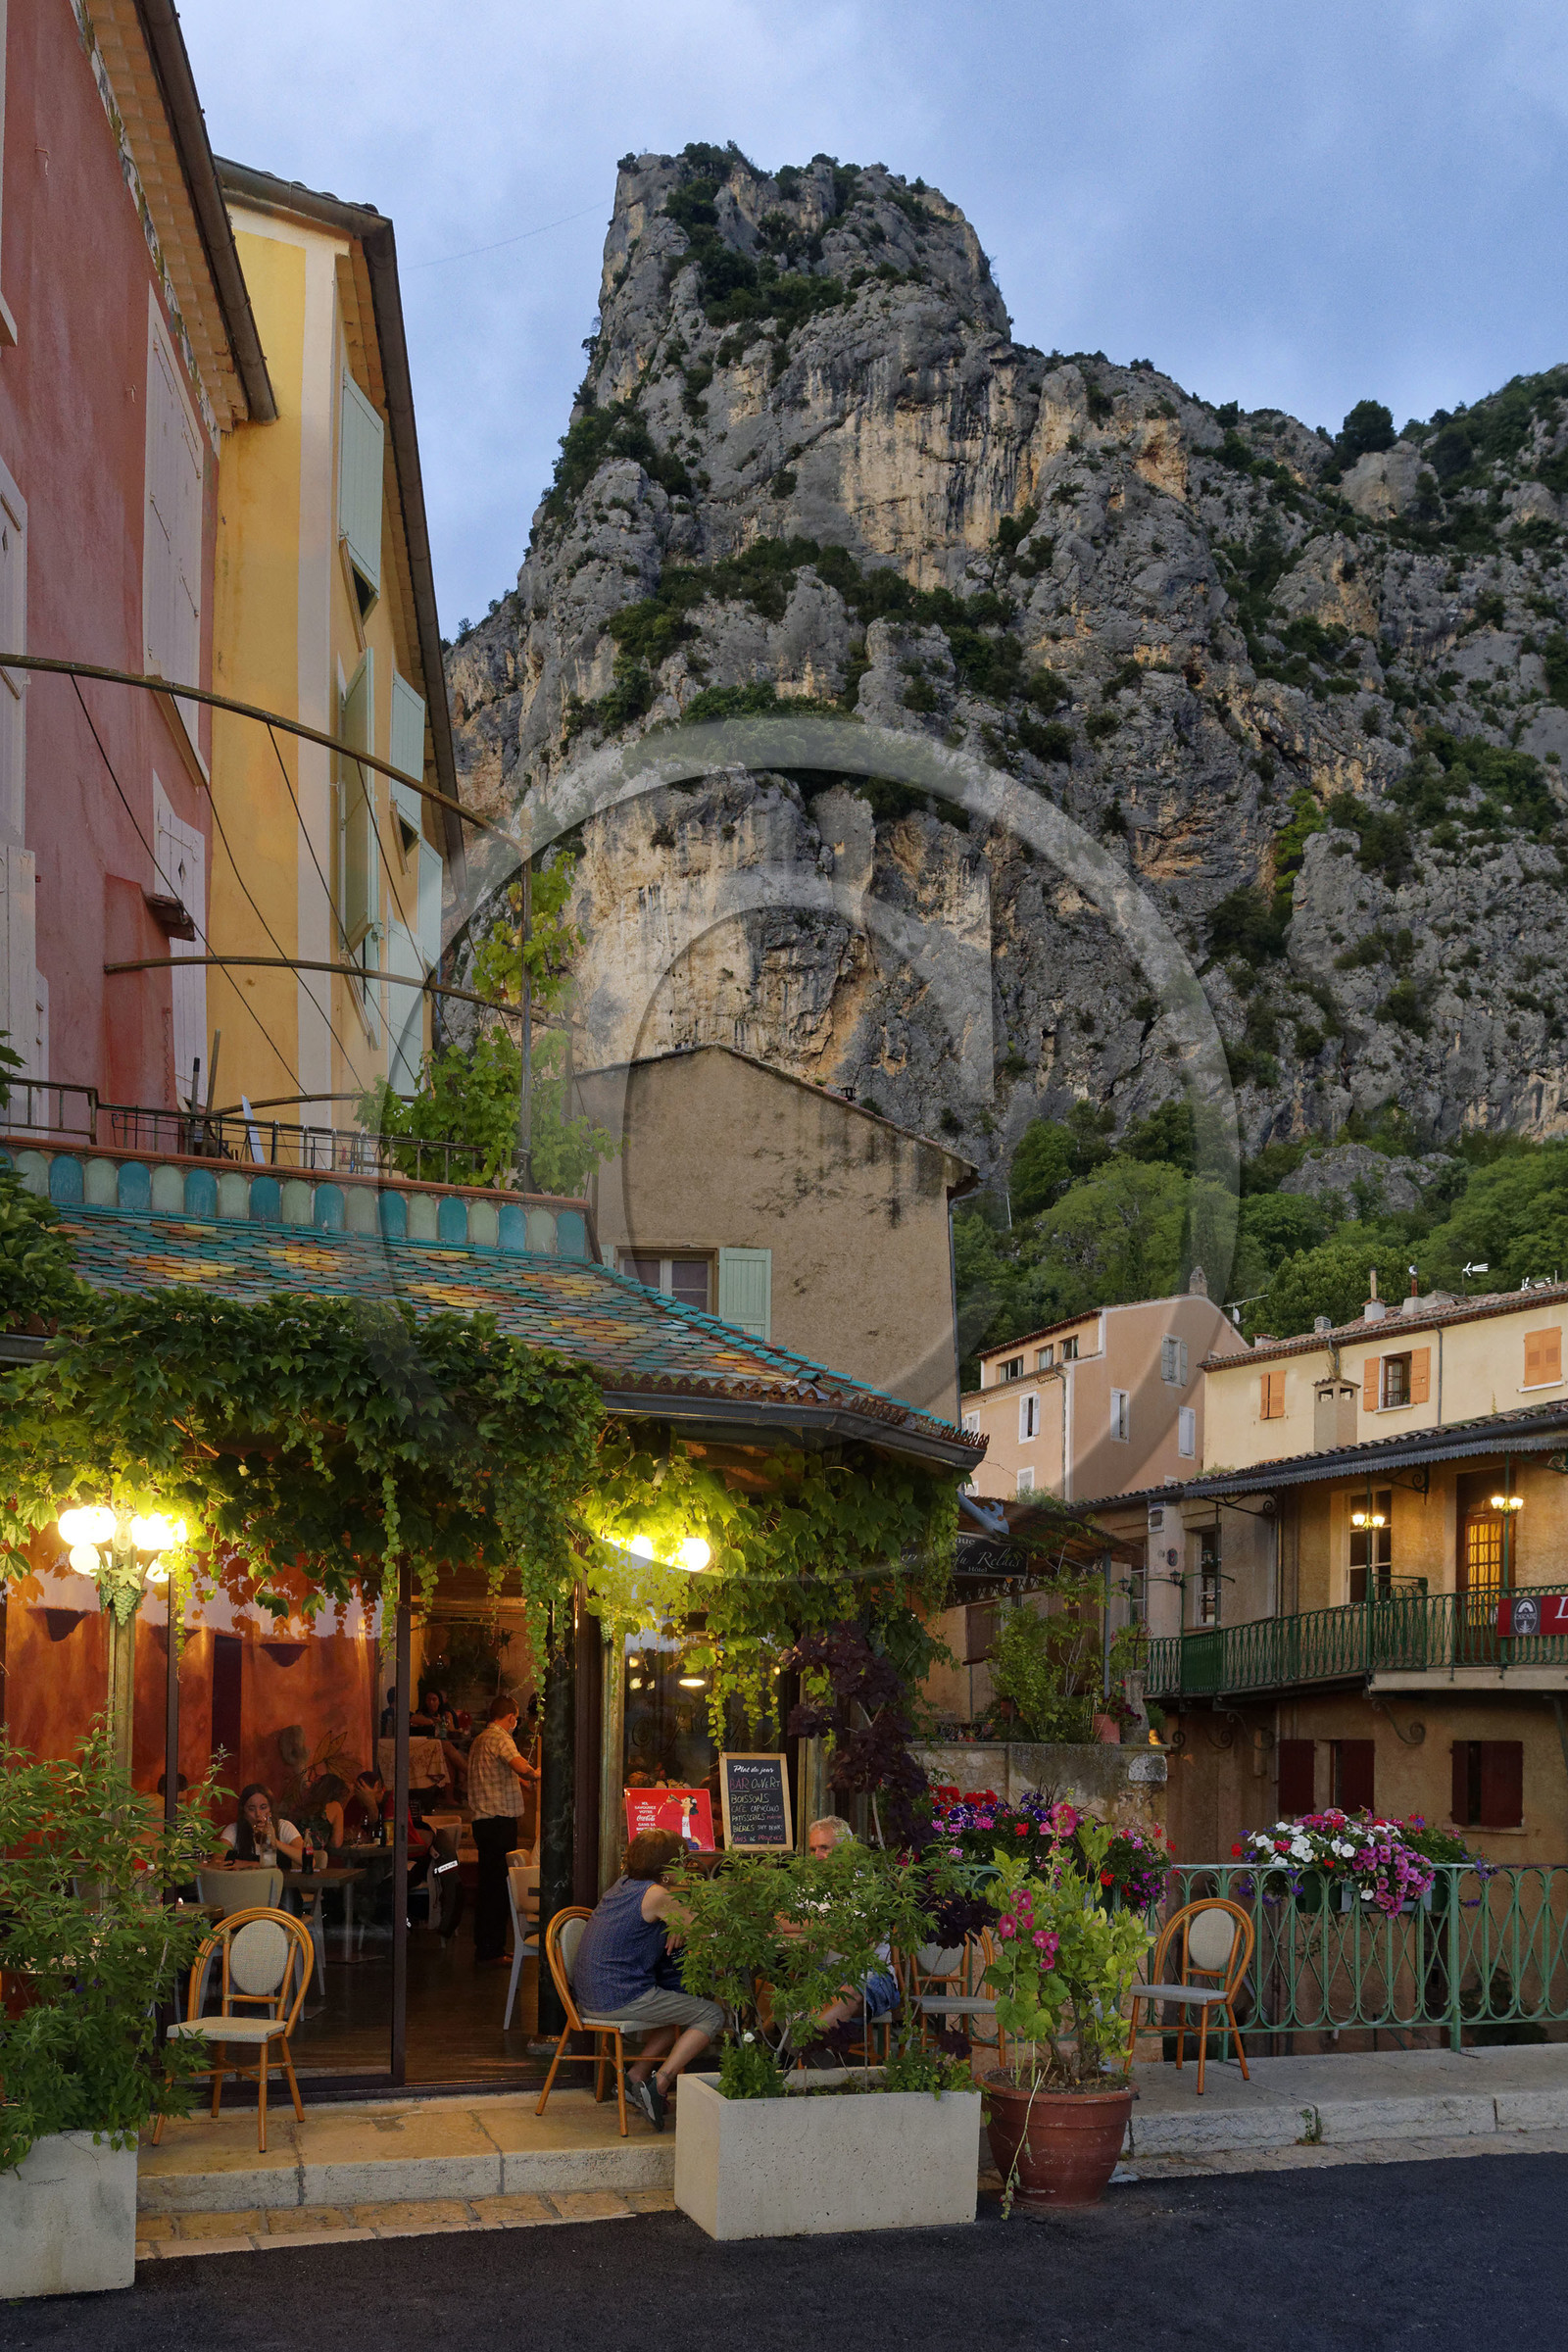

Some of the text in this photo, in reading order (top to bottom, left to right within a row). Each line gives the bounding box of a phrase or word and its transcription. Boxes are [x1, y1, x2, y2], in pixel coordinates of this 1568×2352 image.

[977, 1546, 1021, 1570] Relais
[729, 1776, 750, 1789] BAR
[730, 1792, 770, 1804] BOISSONS
